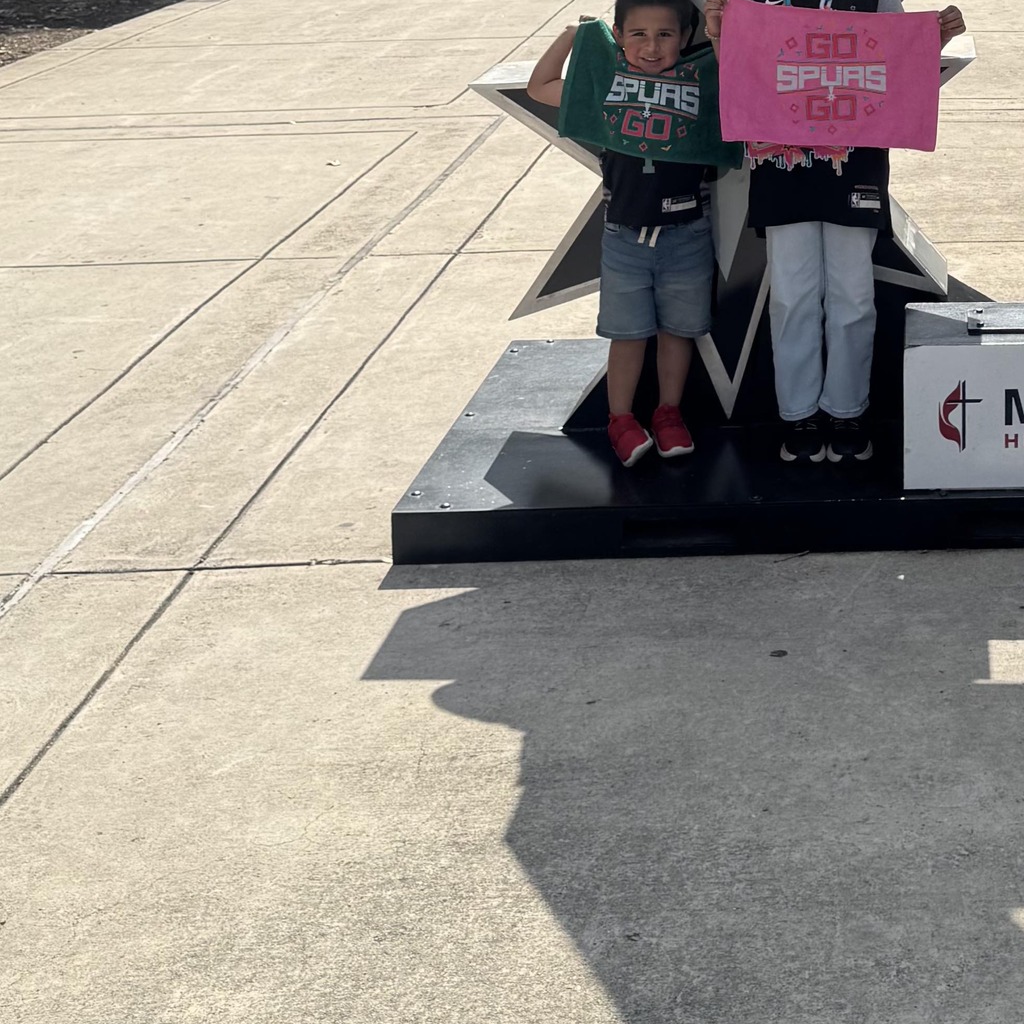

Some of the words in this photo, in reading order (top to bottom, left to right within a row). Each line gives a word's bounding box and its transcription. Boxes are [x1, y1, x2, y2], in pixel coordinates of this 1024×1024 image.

[806, 33, 857, 58] GO
[777, 65, 886, 91] SPURS
[605, 75, 700, 116] SPURS
[806, 96, 856, 120] GO
[621, 109, 672, 141] GO
